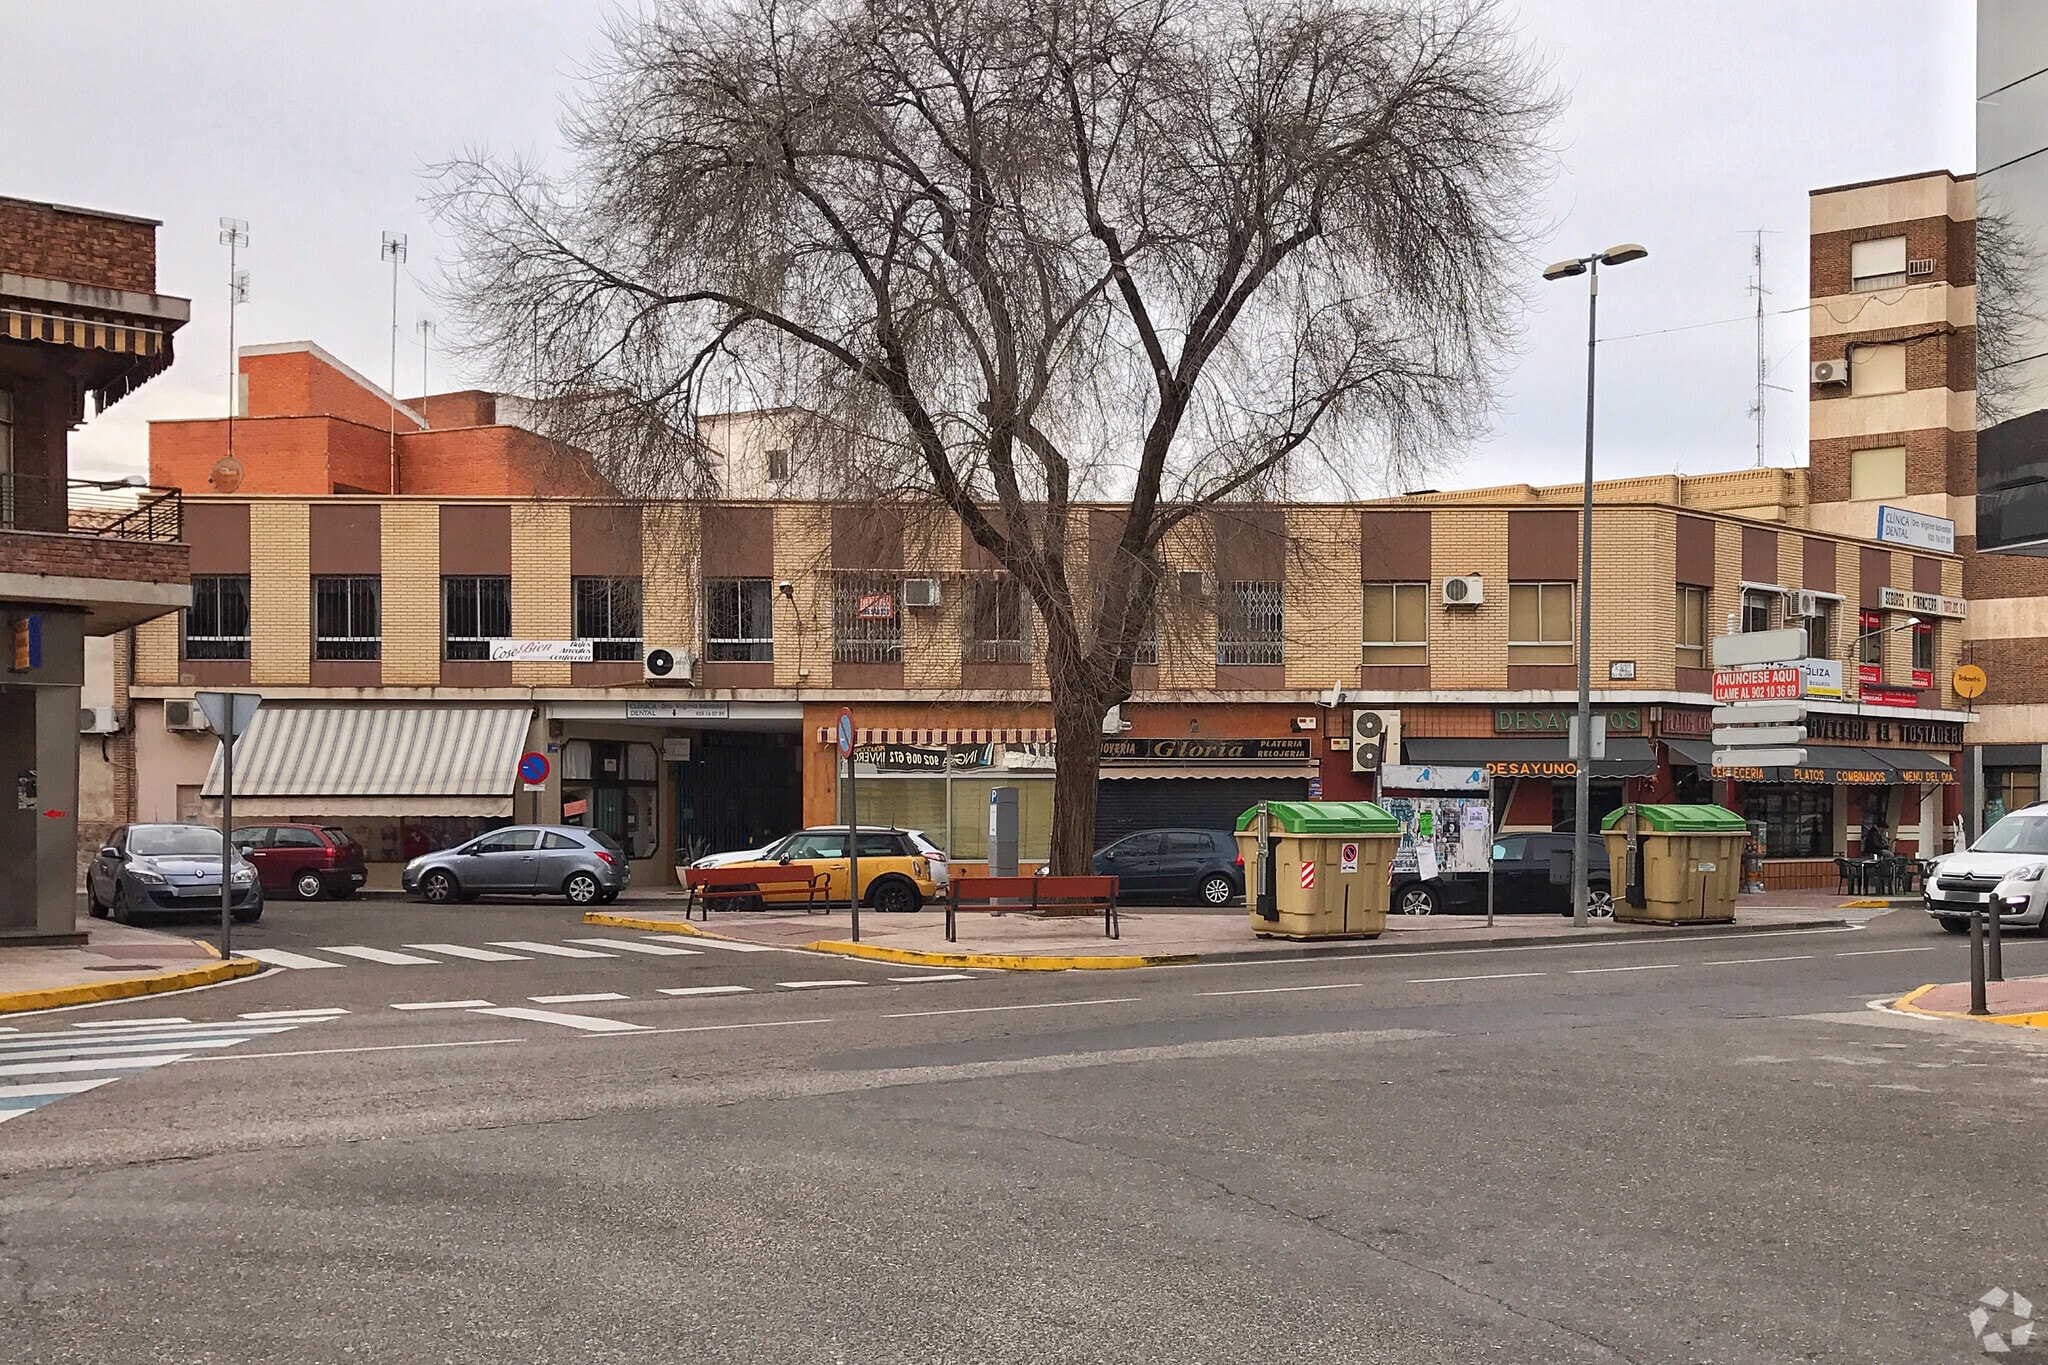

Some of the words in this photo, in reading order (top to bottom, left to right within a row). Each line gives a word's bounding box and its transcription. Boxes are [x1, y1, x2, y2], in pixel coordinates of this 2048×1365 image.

[1886, 525, 1909, 539] DENTAL
[492, 646, 520, 660] Cose
[520, 642, 552, 653] Bien
[1716, 671, 1770, 686] ANUNCIESE
[1772, 669, 1796, 683] AQUI
[1715, 688, 1739, 700] LLAME
[1741, 687, 1750, 699] AL
[1751, 686, 1764, 698] 902
[1767, 686, 1774, 697] 10
[1776, 685, 1785, 697] 36
[1787, 685, 1796, 697] 69
[1499, 711, 1639, 731] DESAYOS
[1881, 723, 1893, 741] EL
[1154, 740, 1244, 757] Gloria
[1260, 740, 1302, 748] PLATERIA
[1257, 750, 1305, 758] RELOJERIA
[1711, 766, 1764, 779] CERECERIA
[1794, 768, 1825, 781] PLATOS
[1836, 771, 1886, 782] COMBINADOS
[1926, 772, 1939, 782] DEL
